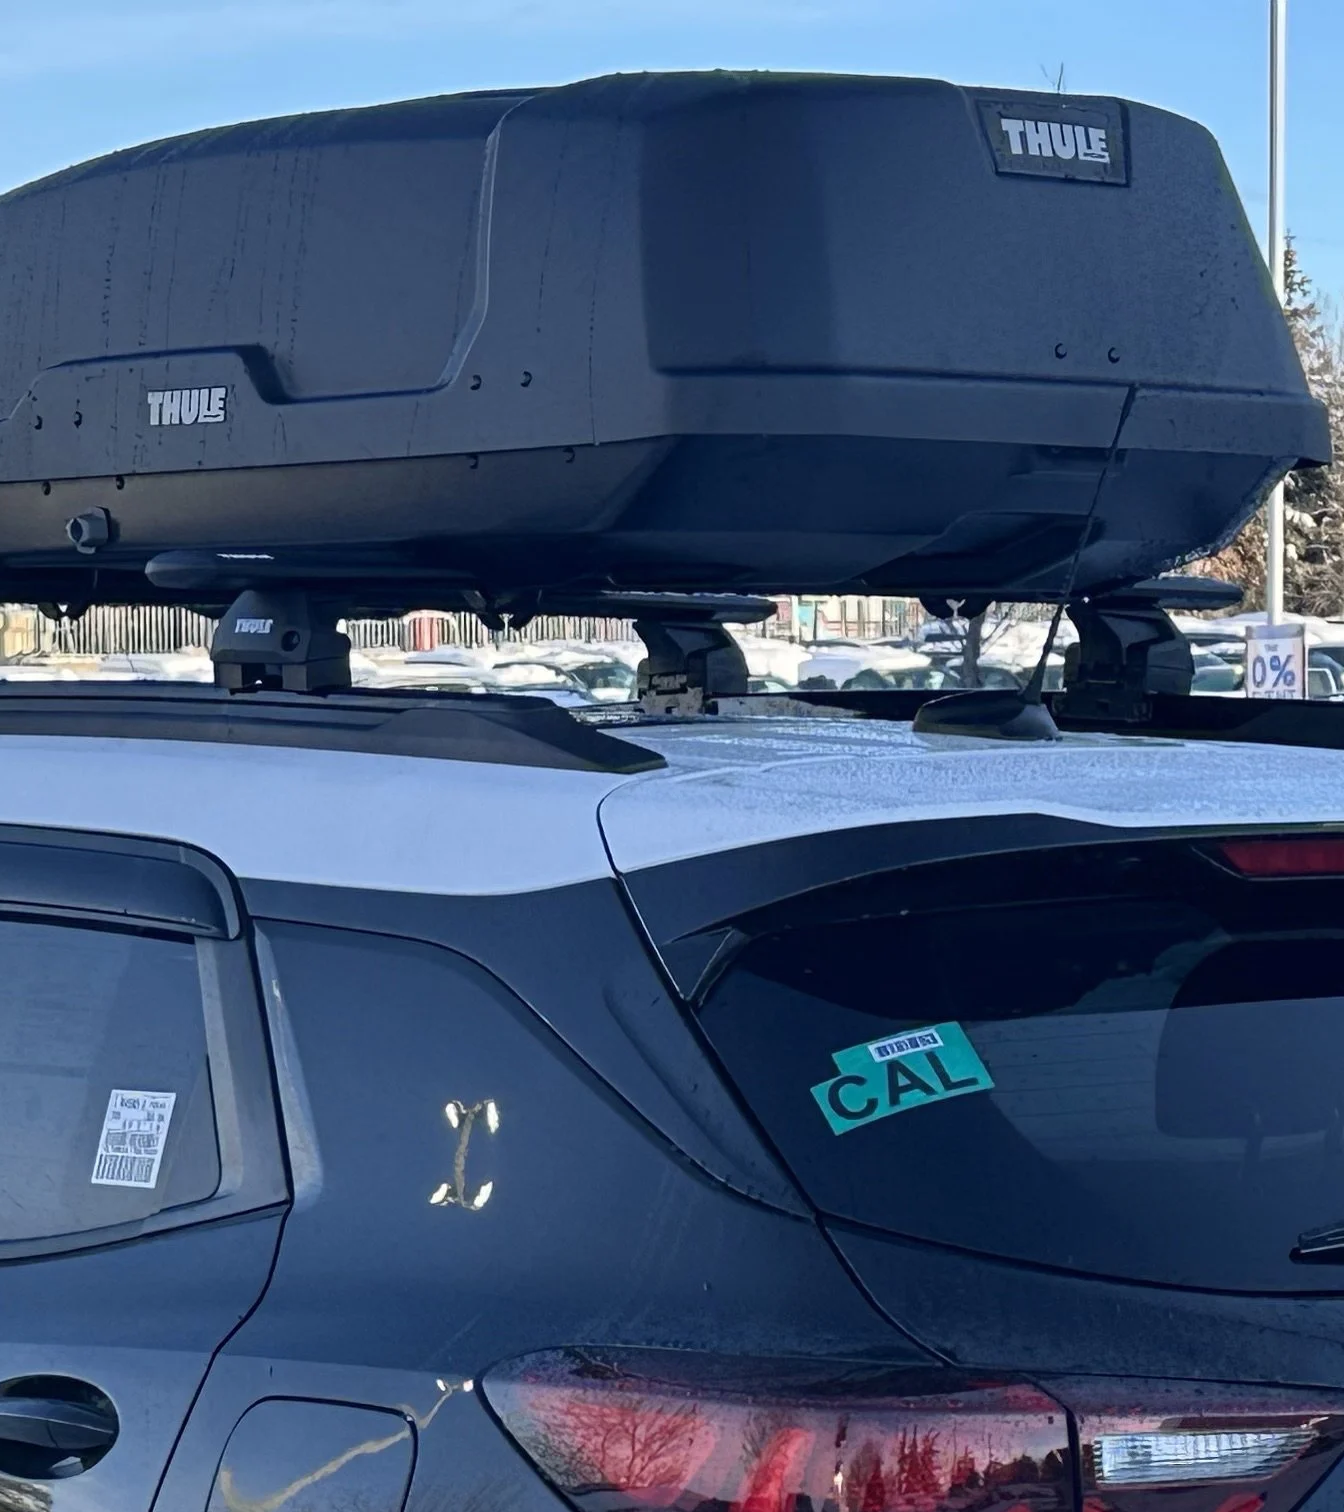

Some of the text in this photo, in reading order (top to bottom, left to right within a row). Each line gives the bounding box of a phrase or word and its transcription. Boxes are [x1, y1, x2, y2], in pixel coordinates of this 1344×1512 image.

[1000, 118, 1111, 164] THULE
[147, 387, 227, 426] THULE
[1252, 654, 1296, 689] 0%
[827, 1051, 980, 1121] CAL
